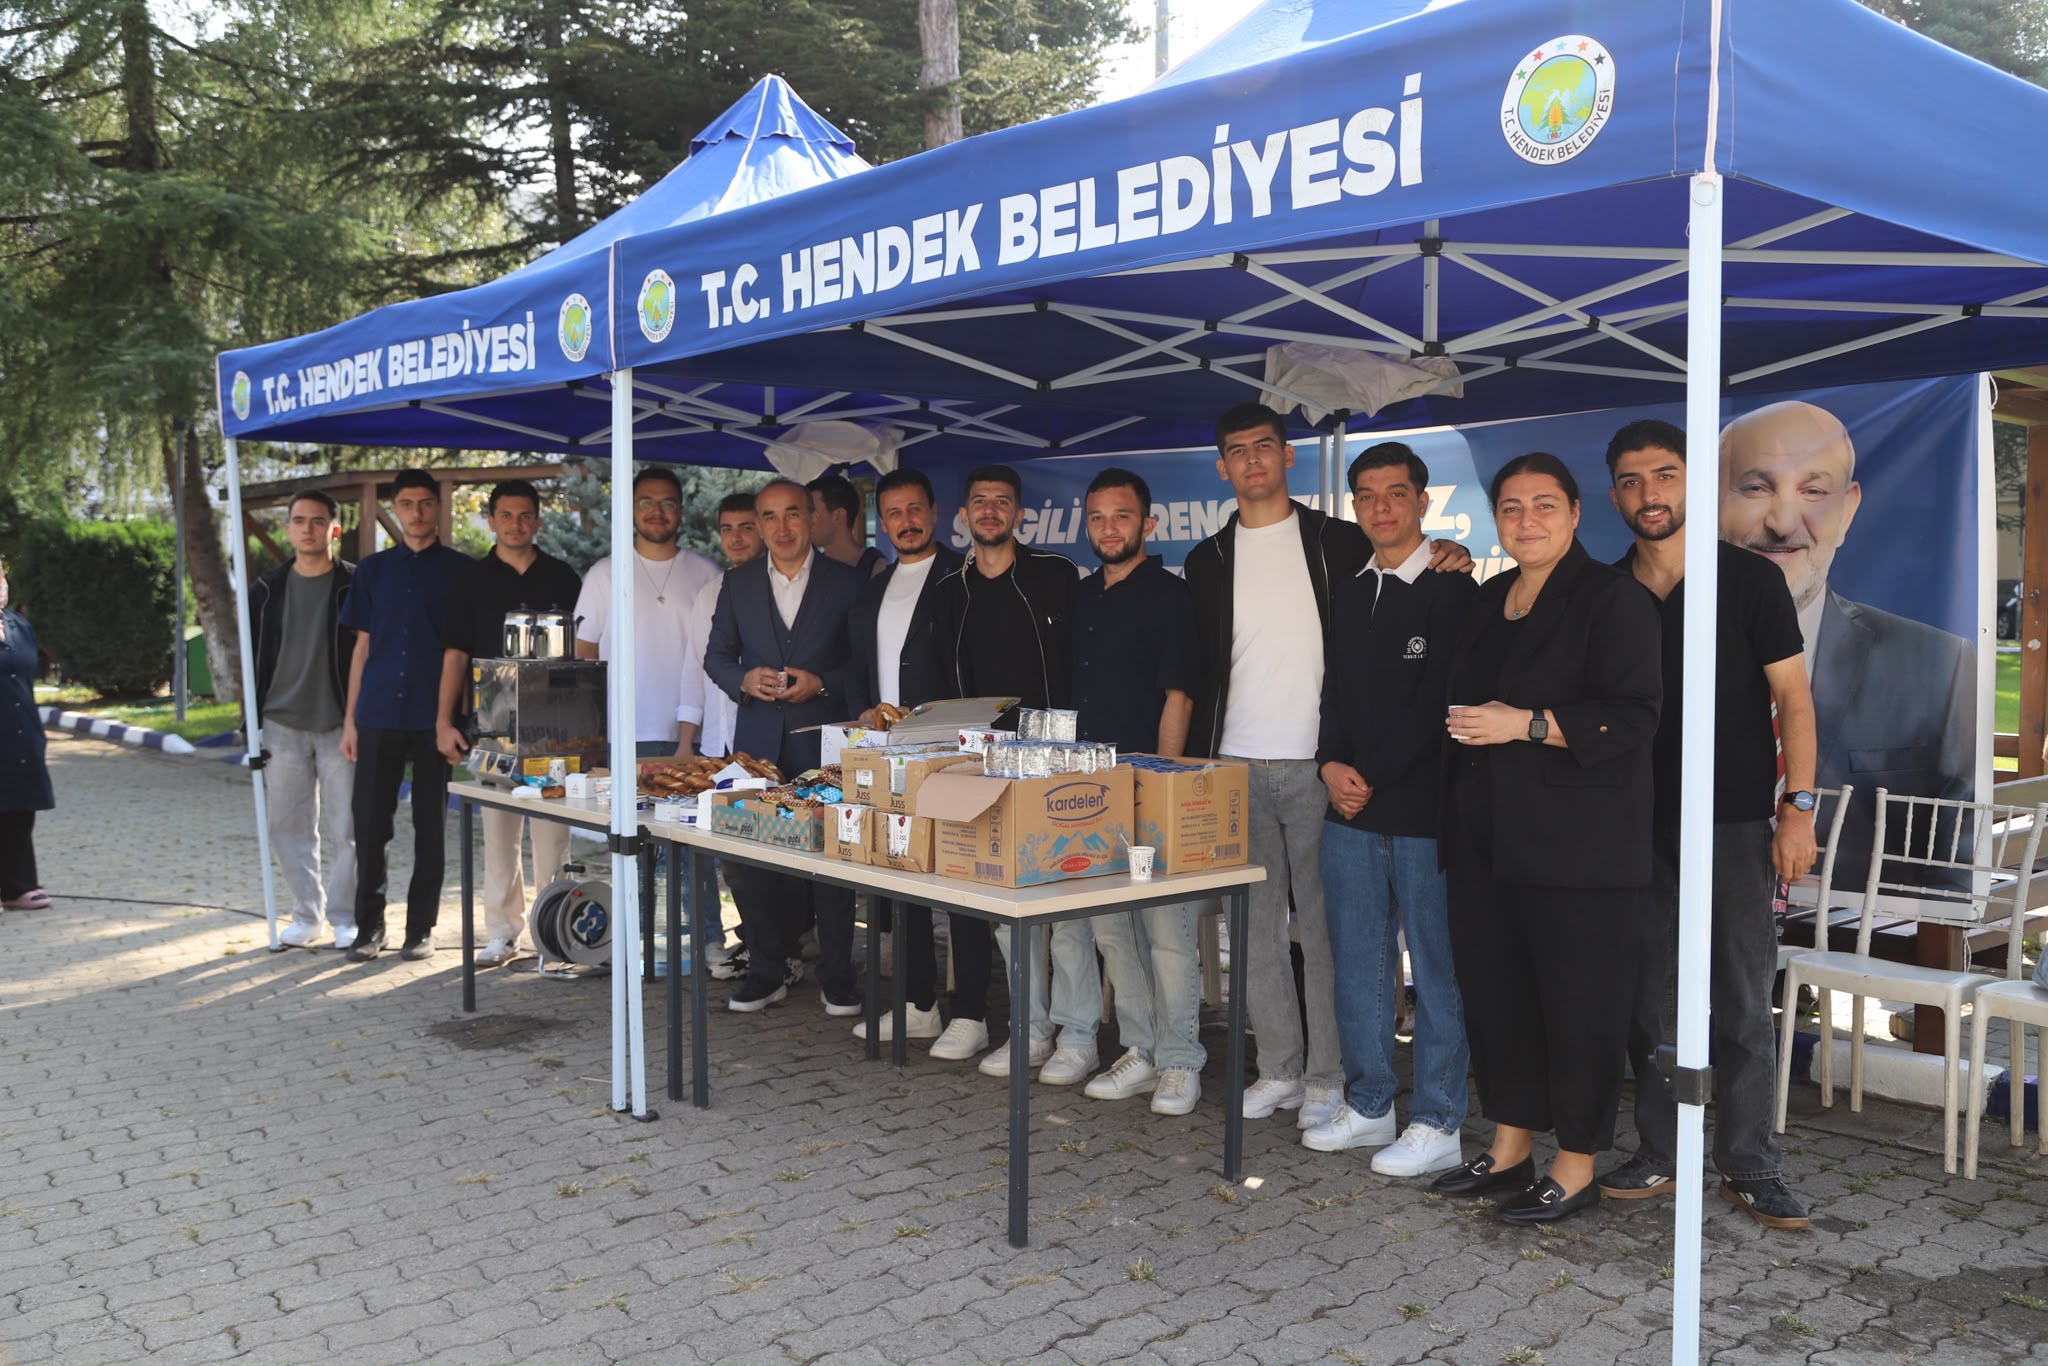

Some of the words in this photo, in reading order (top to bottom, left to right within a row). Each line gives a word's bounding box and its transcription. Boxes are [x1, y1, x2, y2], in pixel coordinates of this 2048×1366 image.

[1509, 130, 1555, 161] HENDEK
[1557, 88, 1611, 159] BELEDİYESİ
[700, 262, 771, 329] T.C.
[782, 202, 984, 312] HENDEK
[997, 72, 1424, 266] BELEDİYESİ
[262, 375, 297, 415] T.C.
[300, 348, 383, 407] HENDEK
[388, 310, 536, 385] BELEDİYESİ
[951, 497, 1082, 548] SGİLİ
[1046, 793, 1104, 812] kardelen
[837, 844, 852, 857] Juss
